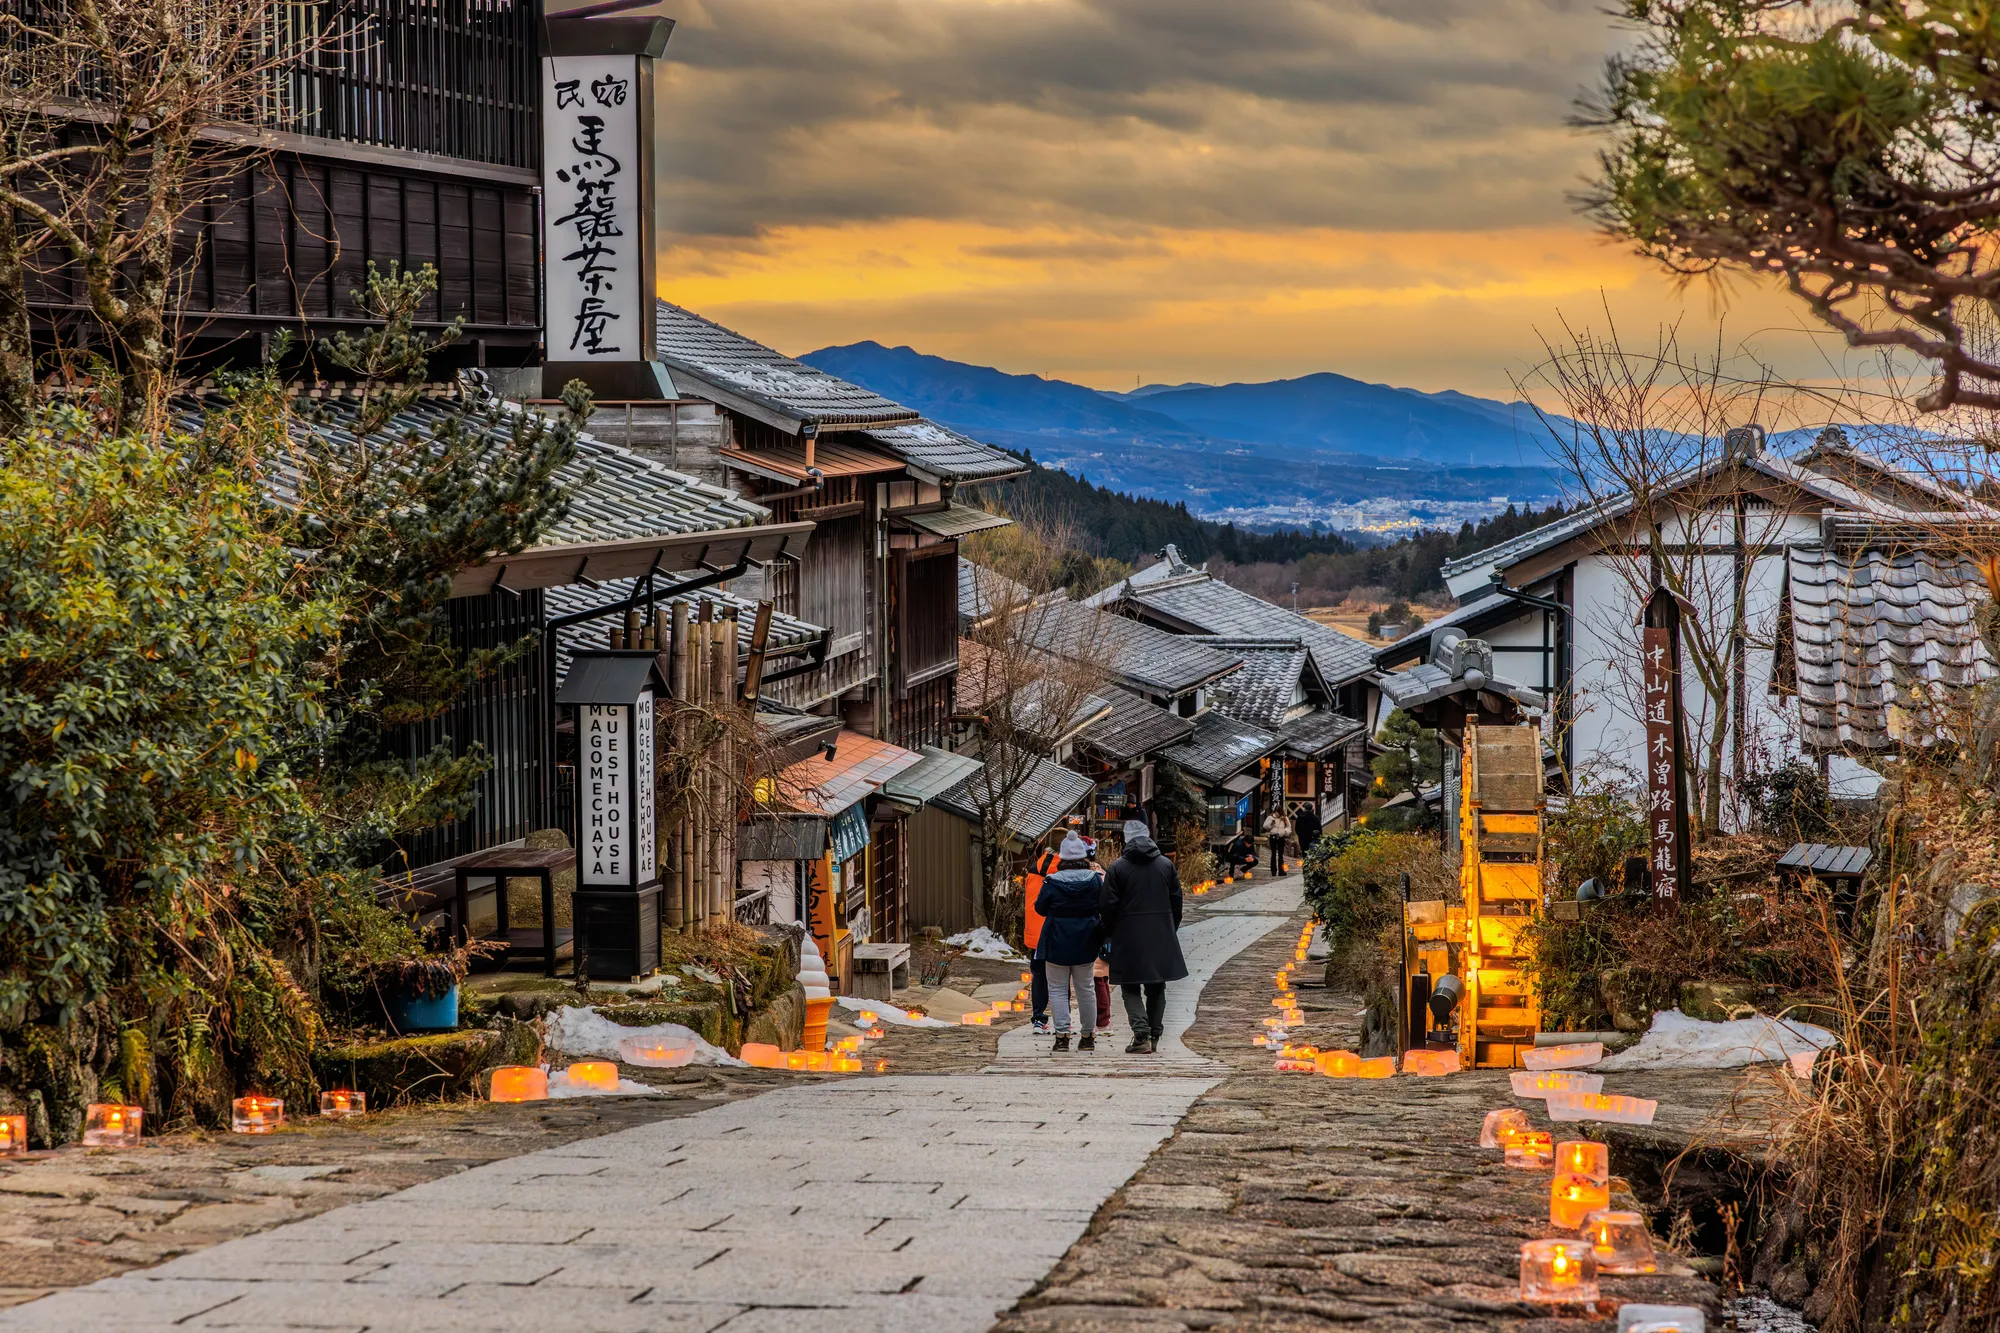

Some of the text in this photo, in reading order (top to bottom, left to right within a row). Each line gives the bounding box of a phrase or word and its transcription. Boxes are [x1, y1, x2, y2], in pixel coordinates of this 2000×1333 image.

[554, 74, 628, 110] 民宿
[553, 115, 624, 355] 馬籠茶屋
[590, 703, 604, 874] MAGOMECHAYA
[607, 705, 619, 874] GUESTHOUSE
